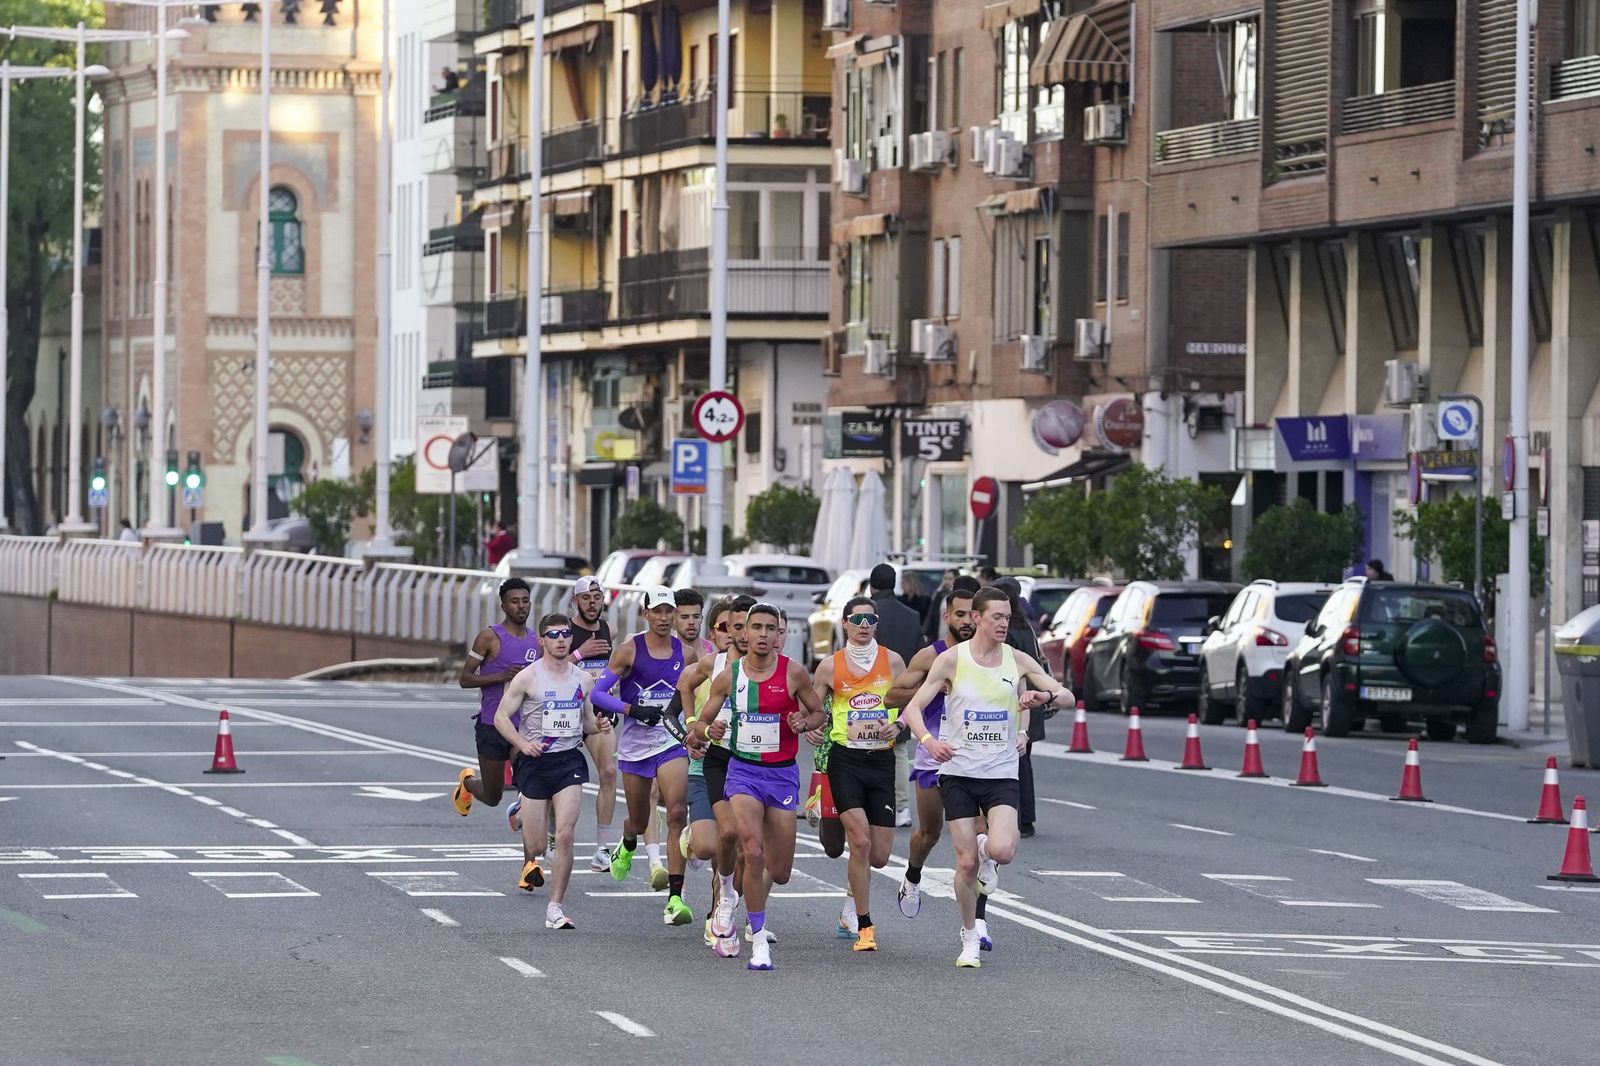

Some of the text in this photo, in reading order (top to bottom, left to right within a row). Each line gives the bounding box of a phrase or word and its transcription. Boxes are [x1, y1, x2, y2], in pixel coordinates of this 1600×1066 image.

[1186, 342, 1247, 354] MARQUE
[904, 421, 961, 436] TINTE
[918, 436, 954, 461] 5€
[676, 444, 699, 474] P
[852, 697, 880, 707] Serrano
[553, 720, 571, 728] PAUL
[751, 735, 762, 743] 50
[967, 732, 1003, 740] CASTEEL
